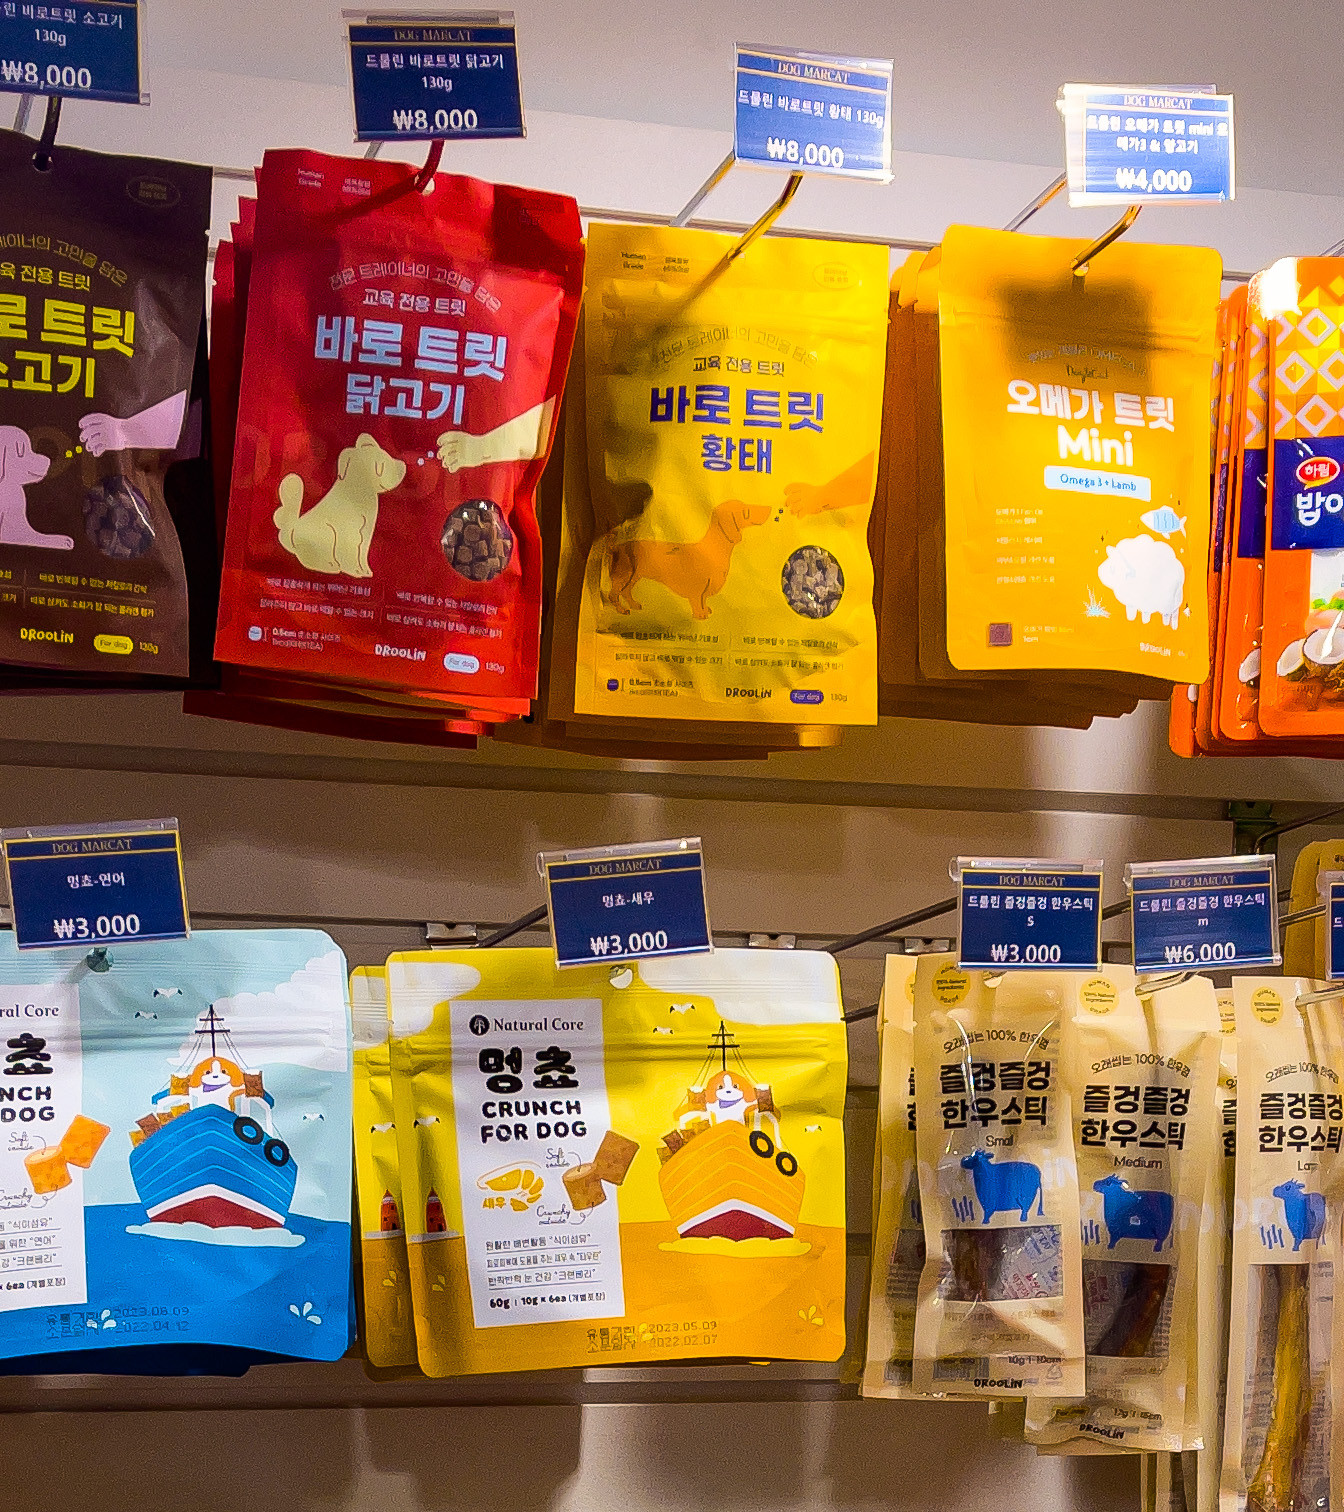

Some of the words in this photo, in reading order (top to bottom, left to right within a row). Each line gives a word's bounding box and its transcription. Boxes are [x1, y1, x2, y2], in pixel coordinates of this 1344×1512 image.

[34, 30, 67, 47] 130g
[421, 75, 452, 92] 130g
[40, 299, 136, 356] 트릿
[314, 314, 404, 368] 바로
[414, 328, 508, 380] 트릿
[345, 373, 464, 424] 닭고기
[649, 386, 732, 426] 바로
[742, 390, 825, 434] 트릿
[700, 436, 773, 474] 황태
[1057, 425, 1134, 467] Mini
[52, 841, 77, 853] DOG
[82, 838, 133, 852] MARCAT
[589, 863, 614, 876] DOG
[617, 859, 661, 874] MARCAT
[27, 1004, 59, 1018] Core
[493, 1018, 547, 1033] Natural
[552, 1018, 584, 1031] Core
[939, 1062, 1051, 1093] 즐겅즐겅
[1, 1106, 55, 1124] DOG
[482, 1101, 581, 1117] CRUNCH
[941, 1098, 1049, 1130] 한우스틱
[481, 1124, 530, 1144] FOR
[536, 1121, 587, 1139] DOG
[1080, 1119, 1185, 1151] 한우스틱
[1258, 1124, 1342, 1154] 한우스틱
